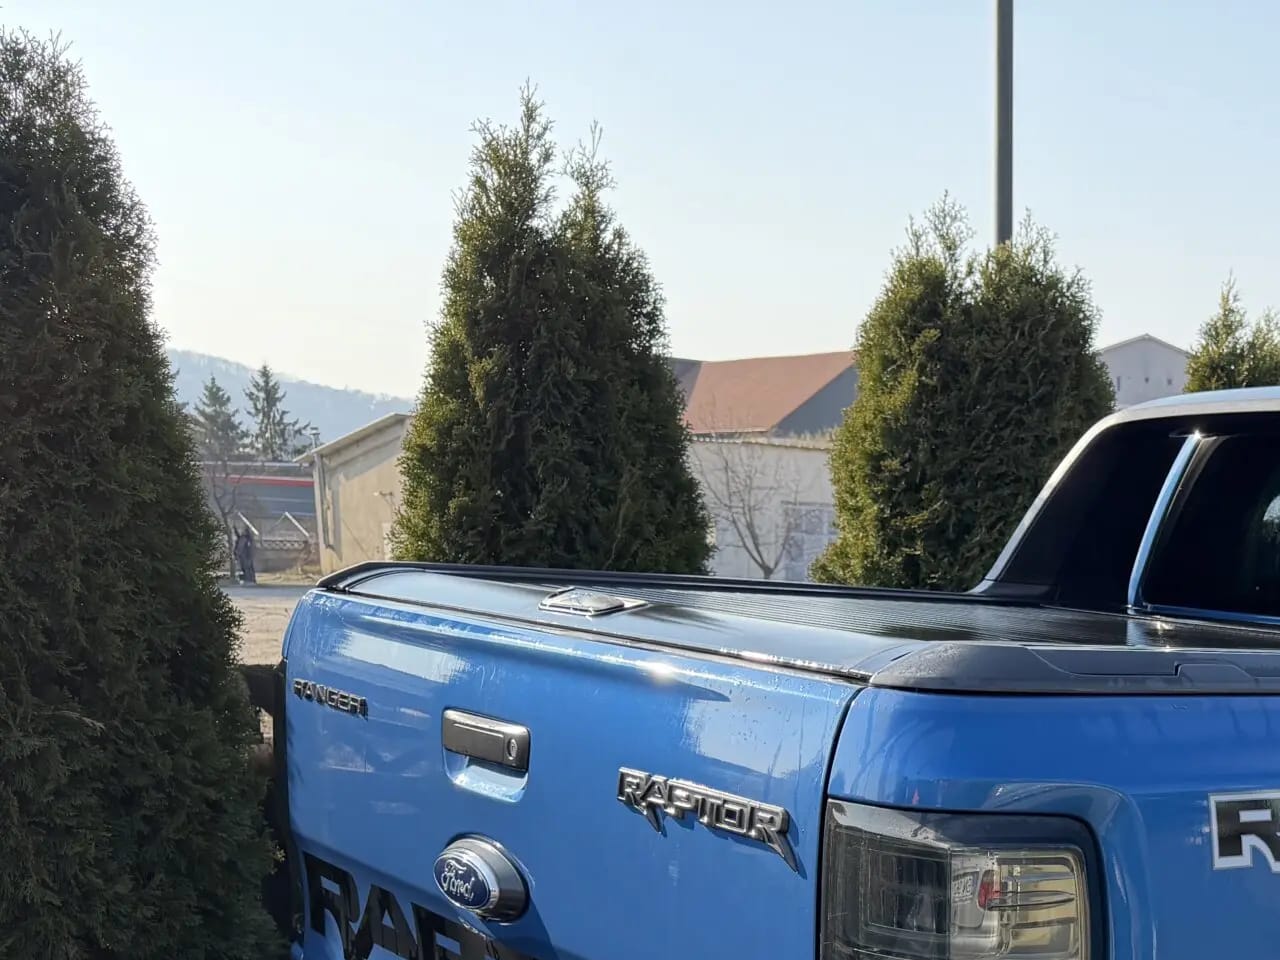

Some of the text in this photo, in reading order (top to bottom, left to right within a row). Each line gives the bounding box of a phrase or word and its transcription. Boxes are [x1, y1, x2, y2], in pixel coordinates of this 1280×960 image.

[293, 678, 368, 717] RANGER
[617, 766, 798, 873] RAPTOR
[441, 859, 476, 901] Ford
